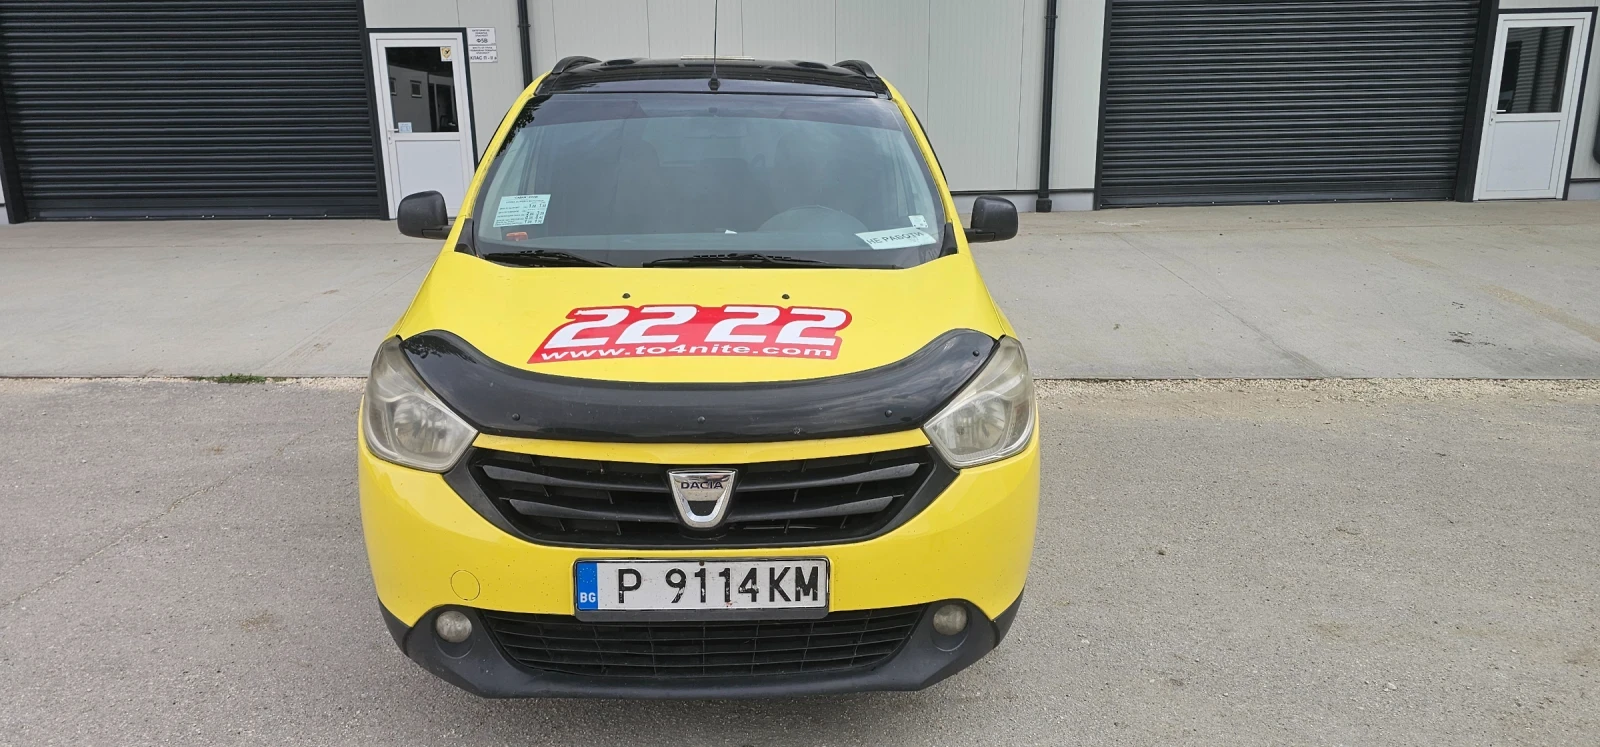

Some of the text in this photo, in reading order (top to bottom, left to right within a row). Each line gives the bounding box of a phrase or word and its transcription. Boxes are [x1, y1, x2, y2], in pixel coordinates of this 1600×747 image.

[866, 232, 924, 245] НЕ РАБОТИ
[544, 305, 847, 349] 22 22
[541, 343, 832, 360] www.to4nite.com
[681, 481, 723, 490] DACIA
[618, 568, 642, 603] P
[580, 592, 596, 603] BG
